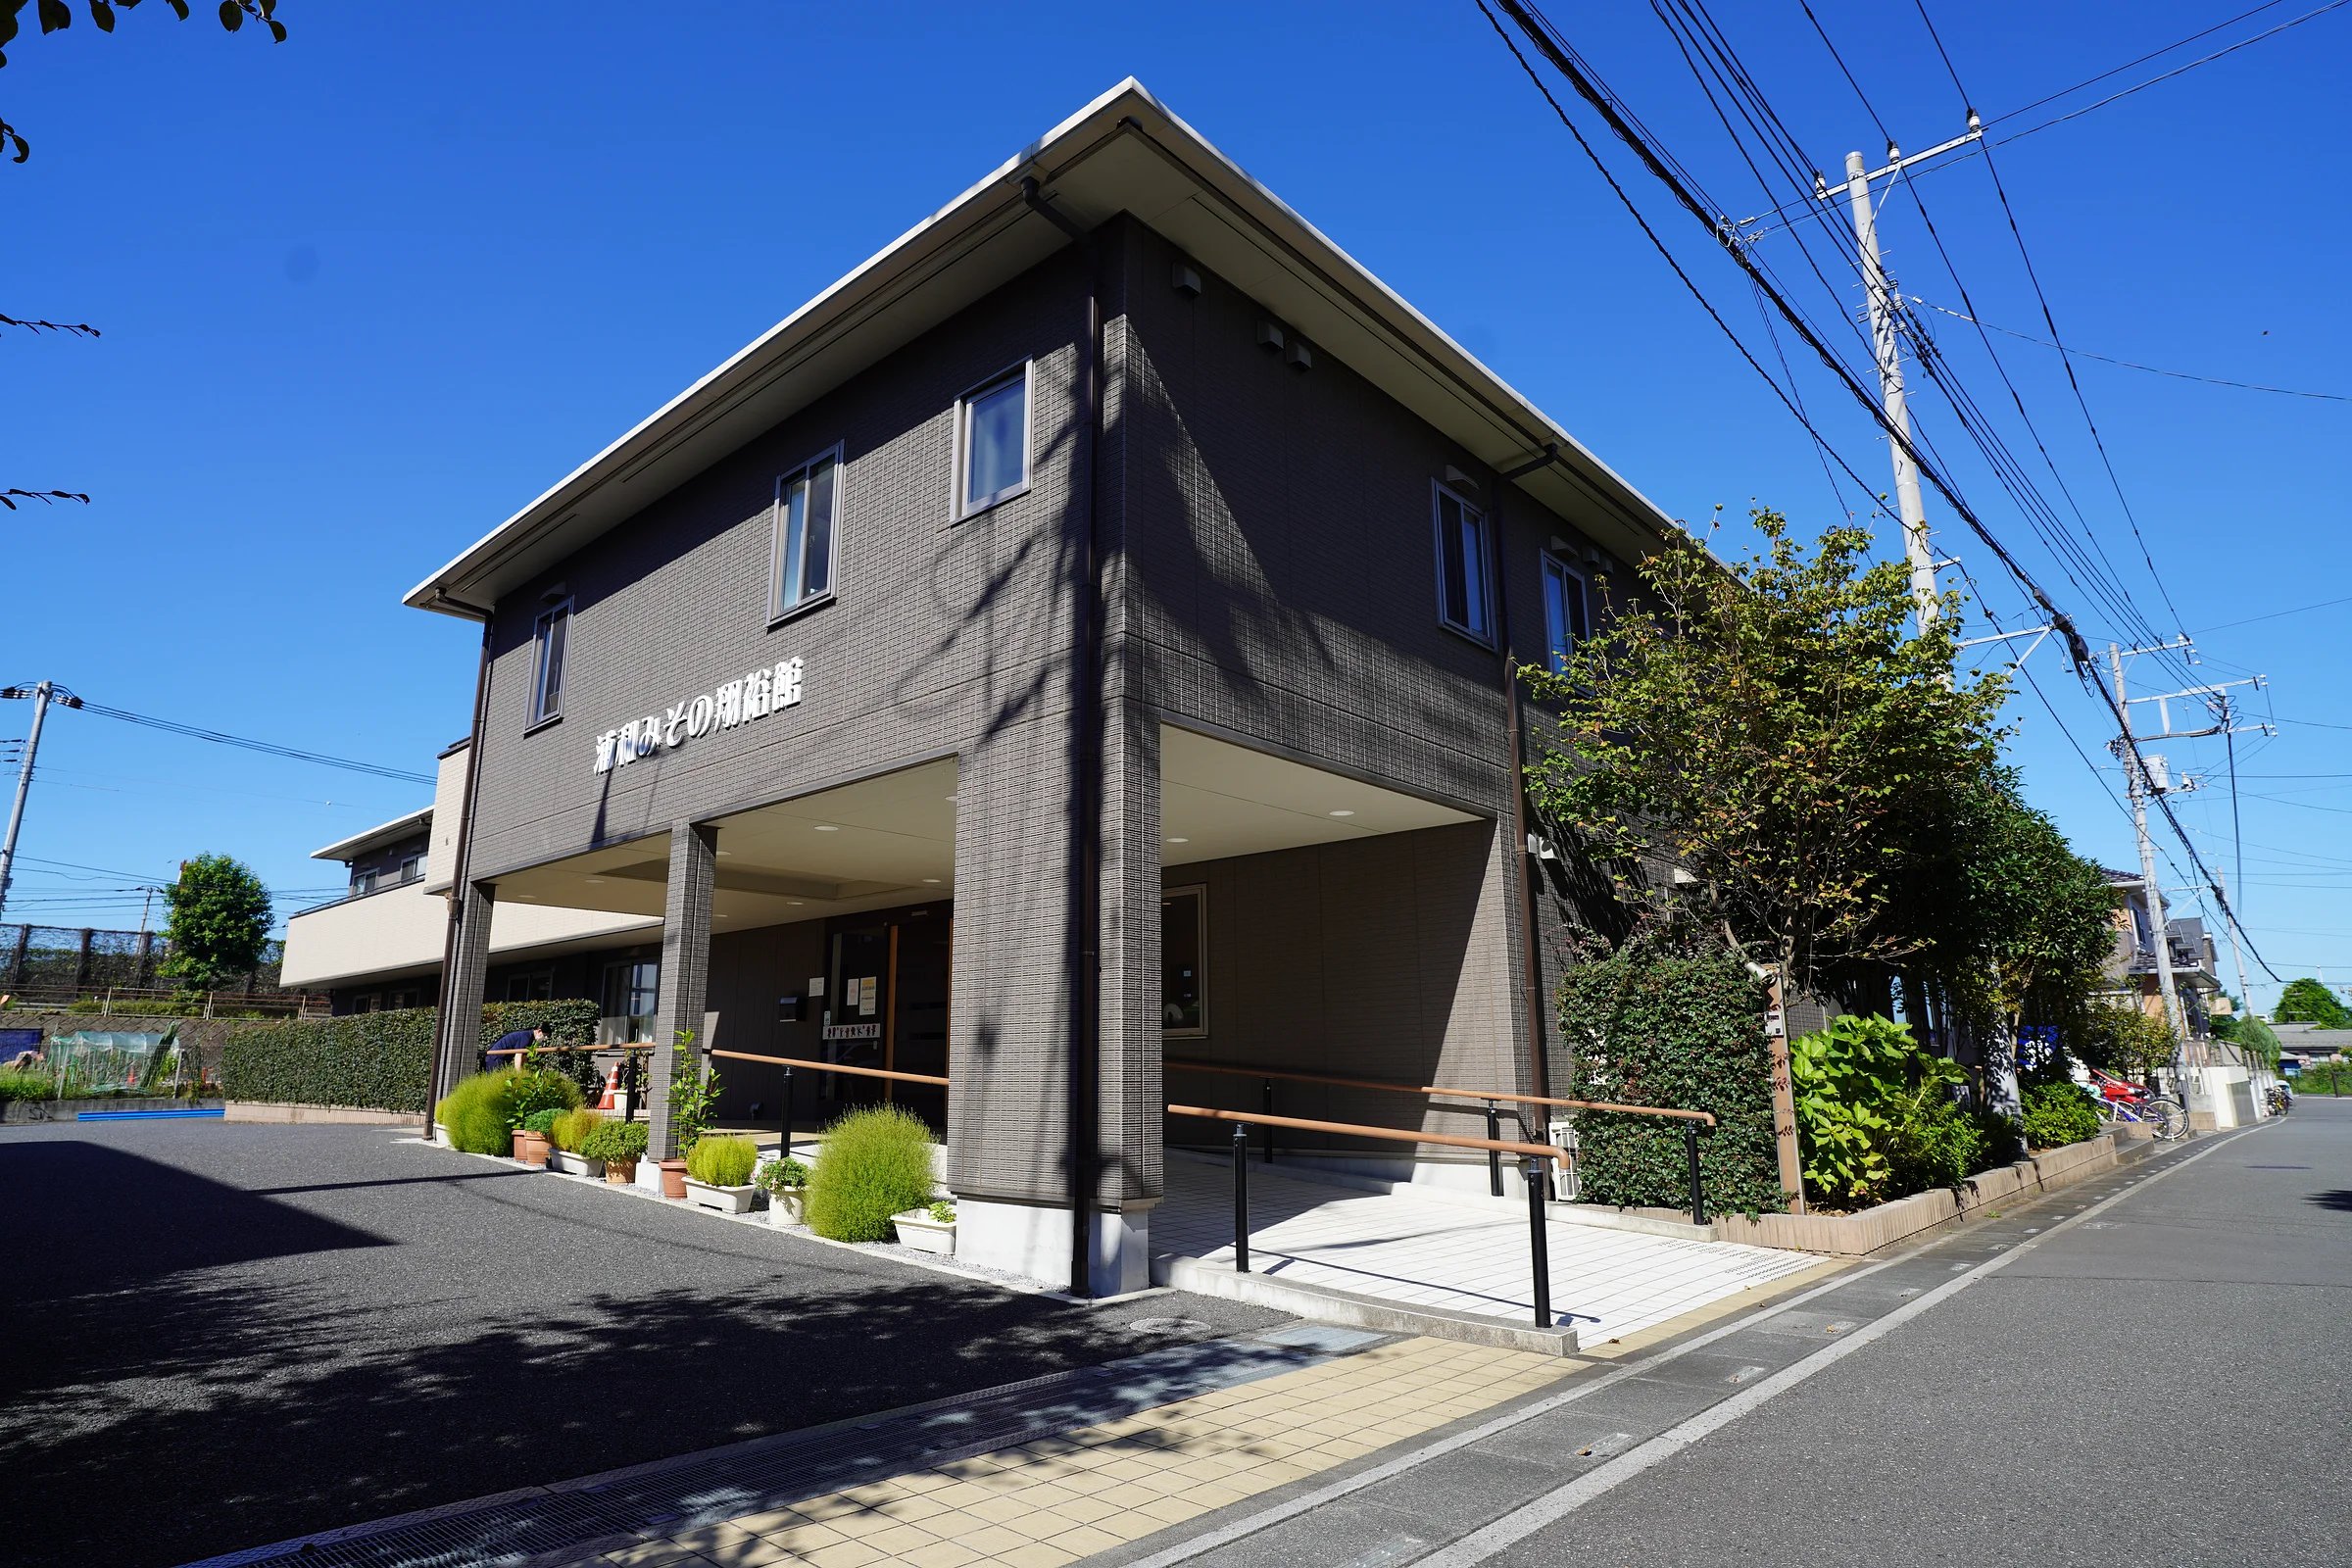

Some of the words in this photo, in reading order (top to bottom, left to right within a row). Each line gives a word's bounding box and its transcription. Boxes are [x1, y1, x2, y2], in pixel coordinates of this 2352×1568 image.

[593, 656, 805, 774] 浦和みその翔裕館
